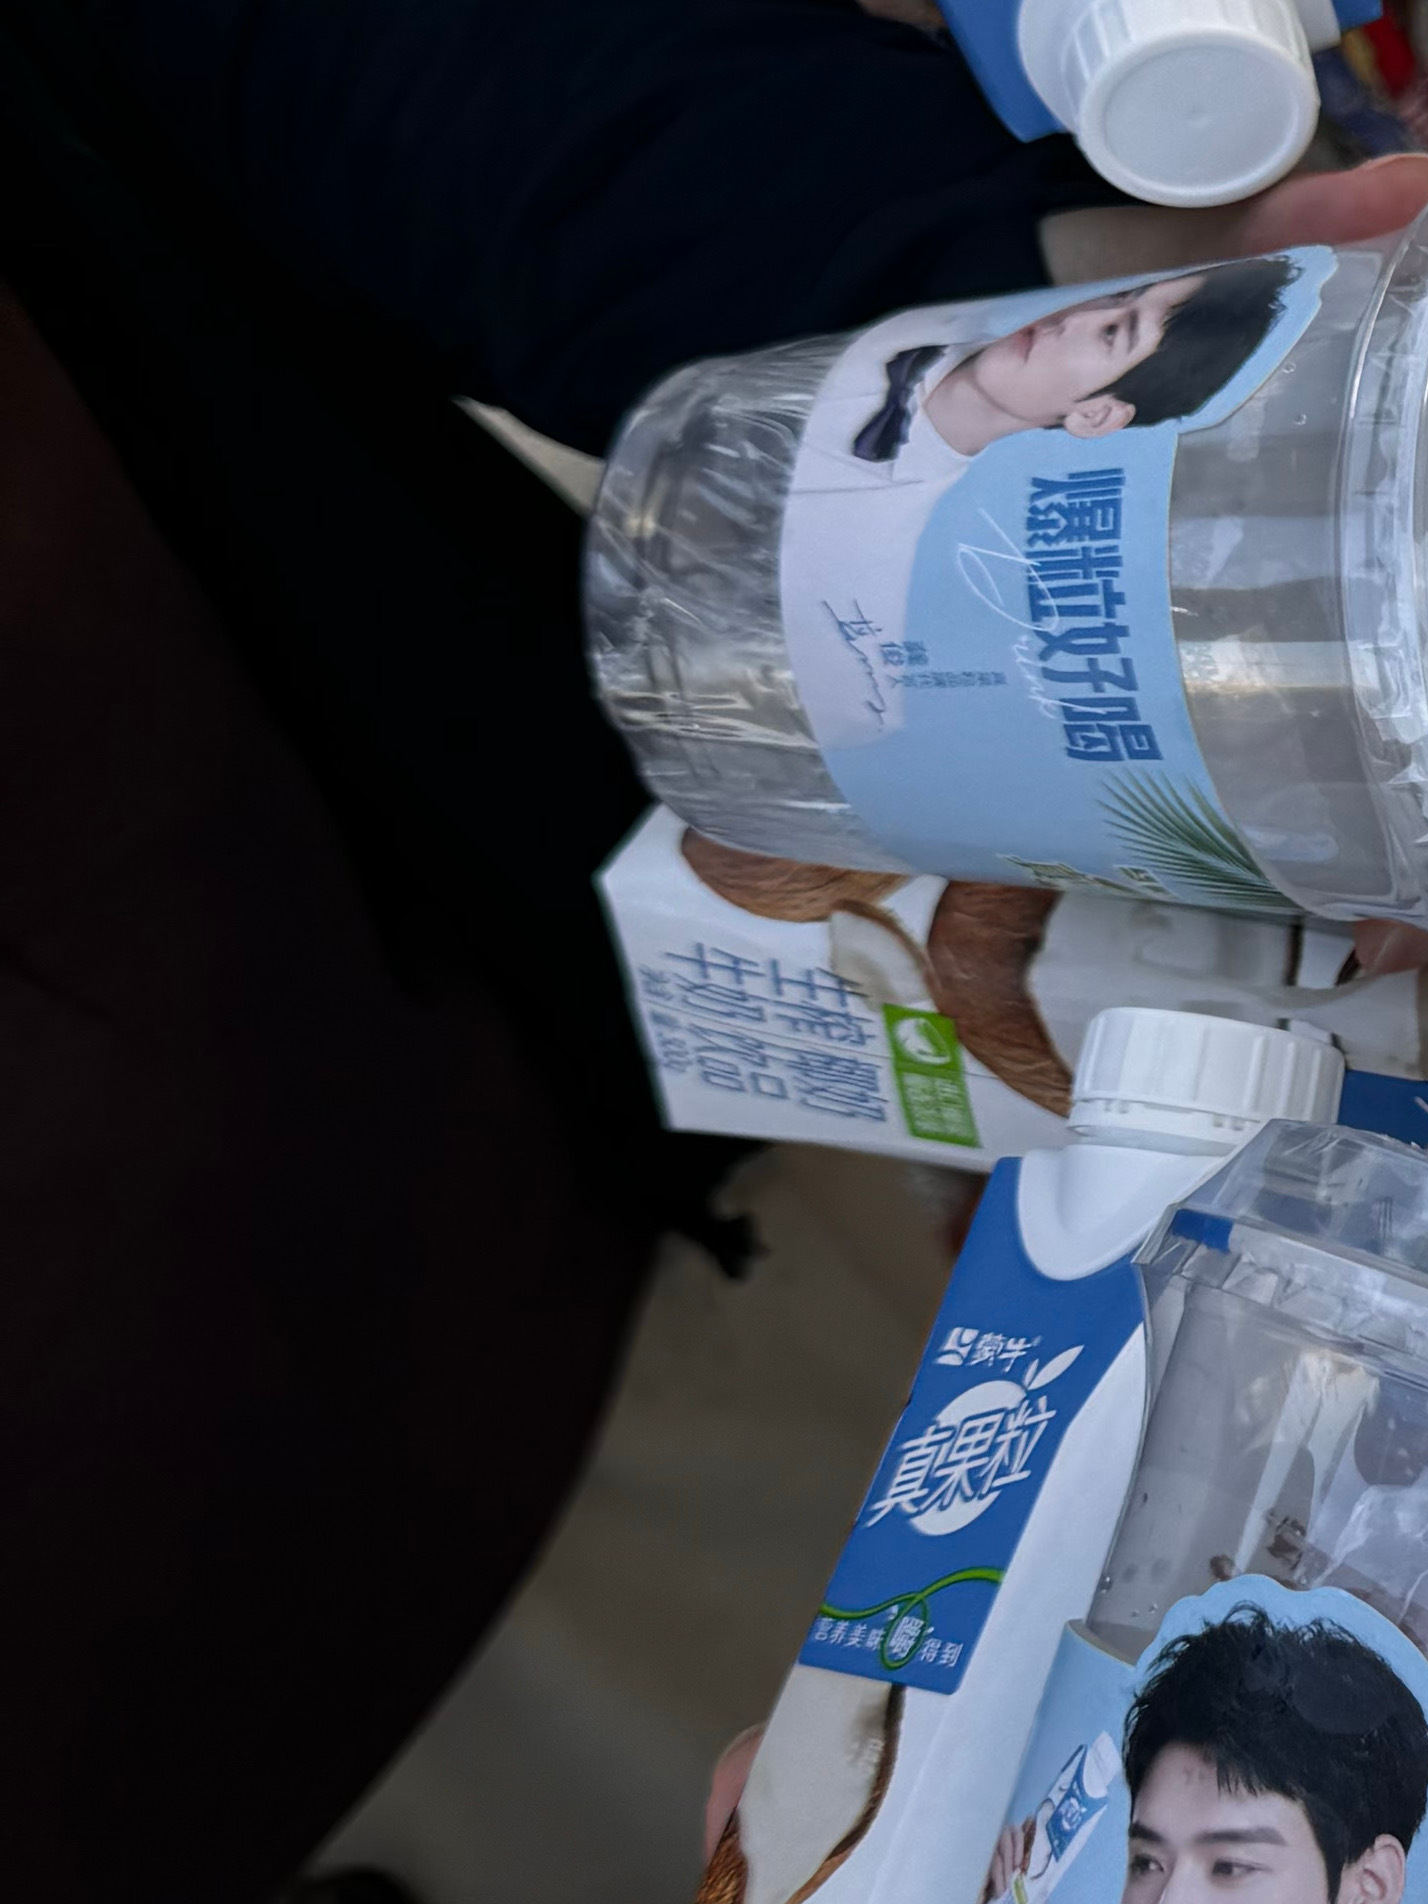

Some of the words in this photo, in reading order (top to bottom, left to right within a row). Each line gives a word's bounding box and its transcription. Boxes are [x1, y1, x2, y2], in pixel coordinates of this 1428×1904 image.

[1025, 467, 1164, 762] 爆粒好喝
[663, 942, 790, 1099] 牛奶饮品
[765, 957, 889, 1122] 生榨椰奶
[862, 1395, 1058, 1529] 真果粒
